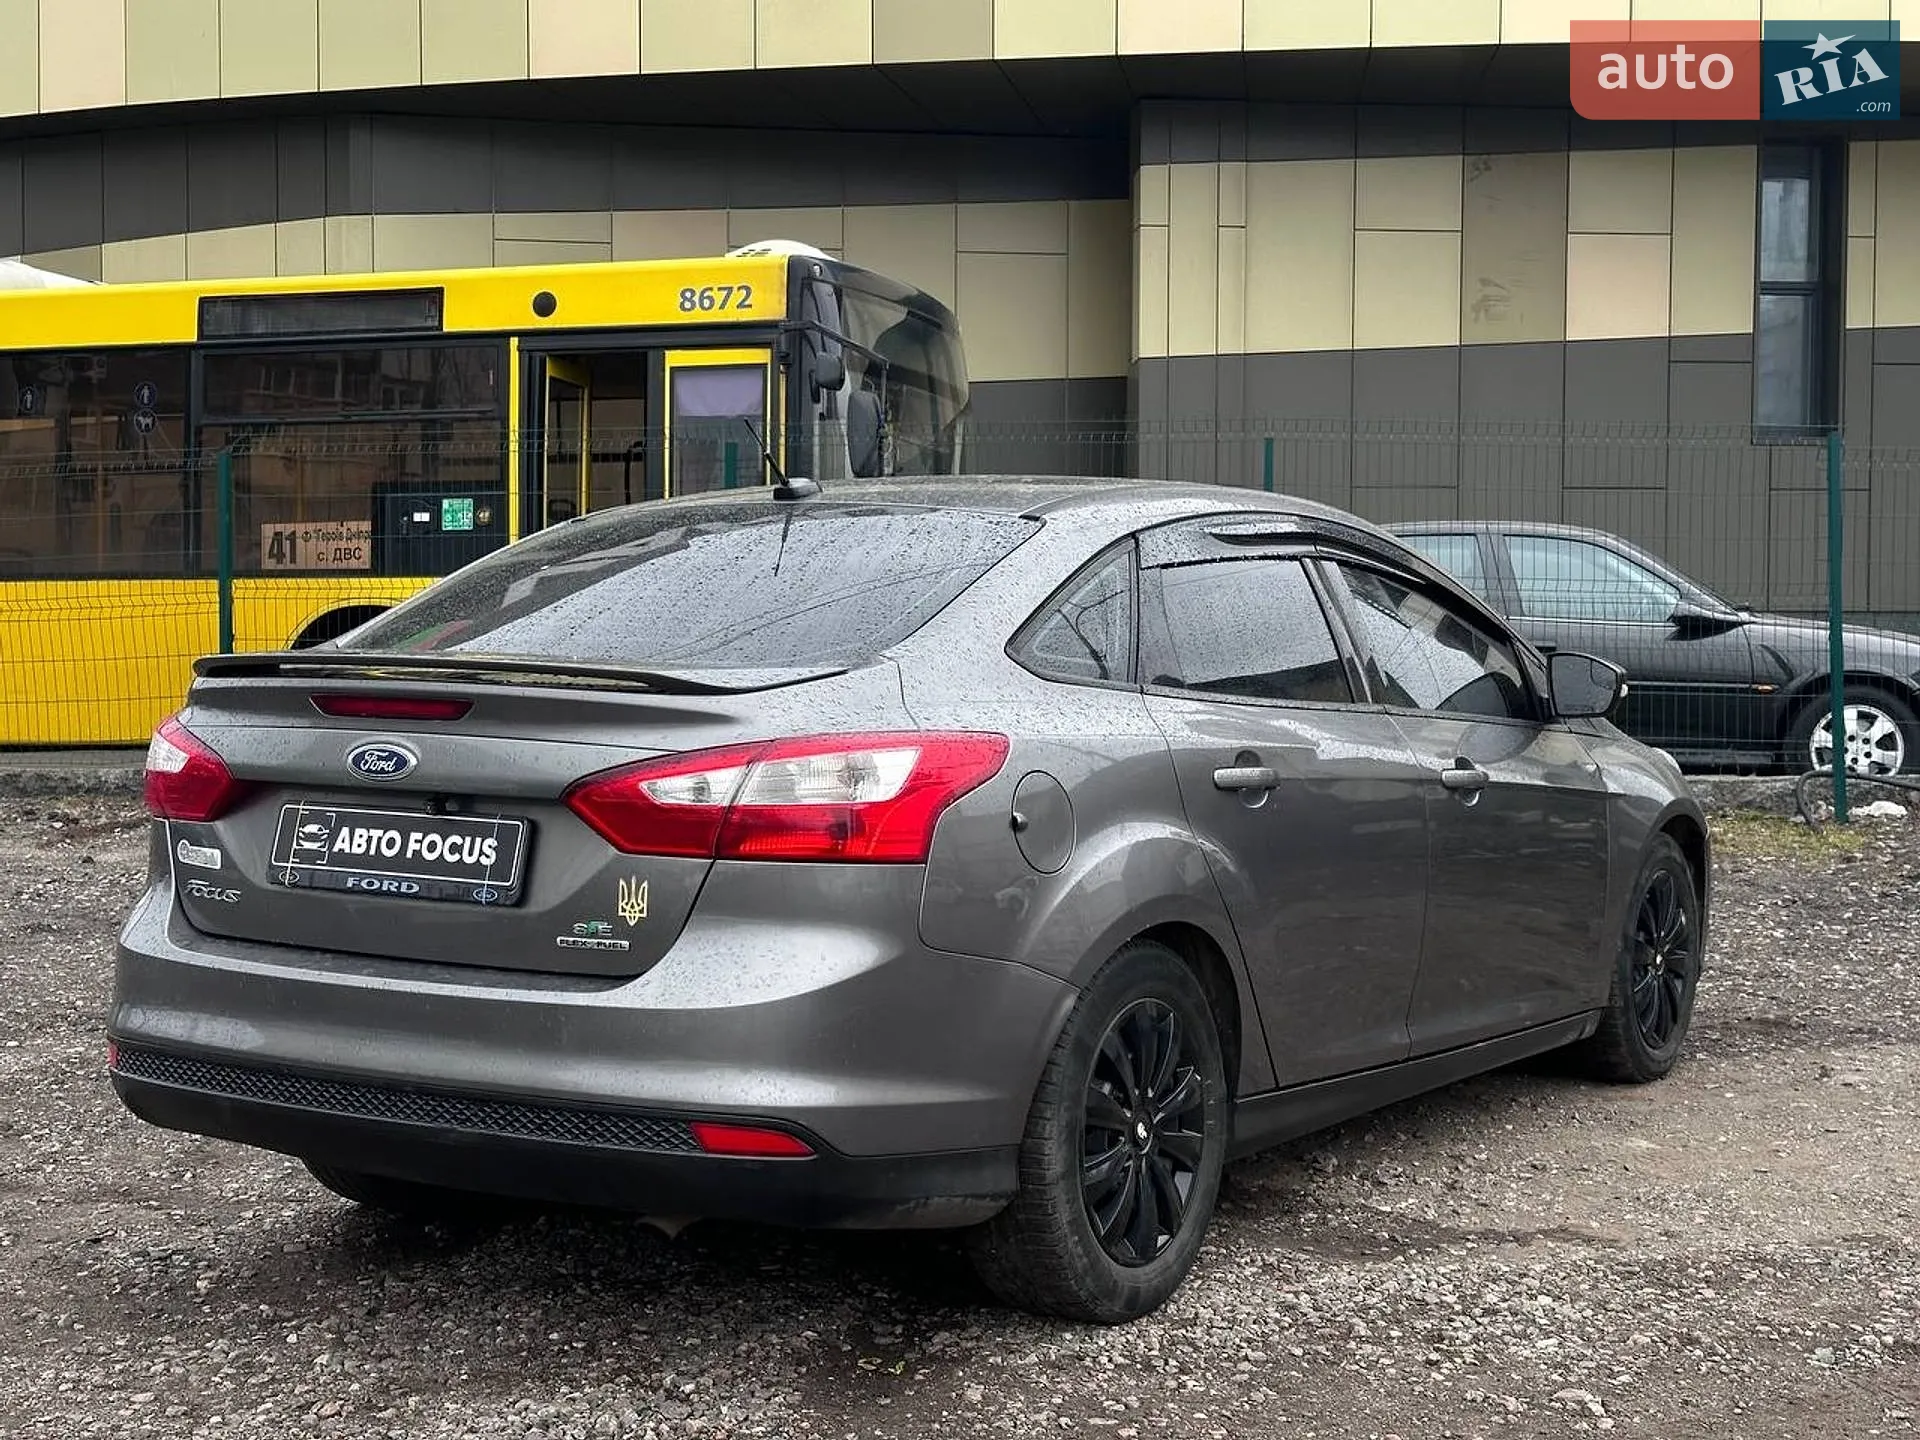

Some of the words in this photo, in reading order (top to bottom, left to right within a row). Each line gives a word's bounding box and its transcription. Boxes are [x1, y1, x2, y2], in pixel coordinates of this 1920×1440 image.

[679, 284, 752, 312] 8672
[268, 530, 296, 565] 41
[333, 547, 362, 563] ДВС
[360, 750, 398, 772] Ford
[406, 832, 498, 865] FOCUS
[346, 877, 420, 893] FORD
